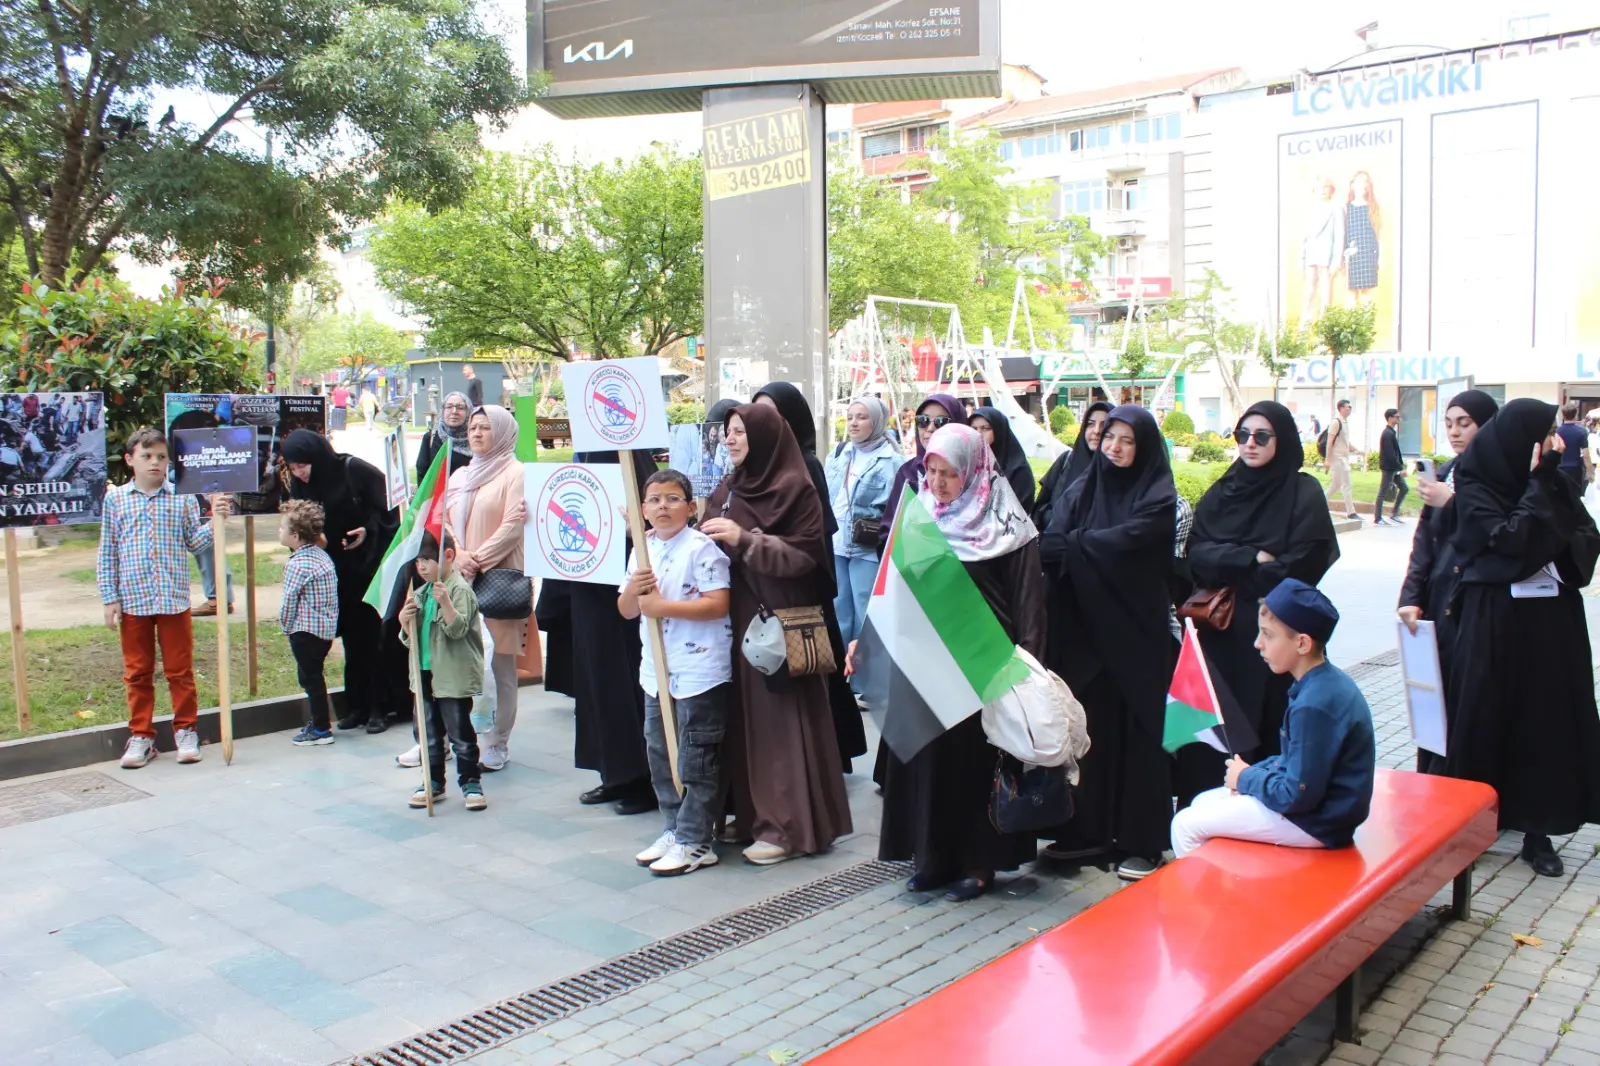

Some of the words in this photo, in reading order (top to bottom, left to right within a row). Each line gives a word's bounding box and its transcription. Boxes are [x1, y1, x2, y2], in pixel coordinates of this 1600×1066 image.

[929, 7, 961, 16] EFSANE
[940, 17, 961, 25] No:31
[908, 29, 922, 38] 262
[925, 28, 938, 38] 325
[563, 39, 633, 63] KIA
[1292, 86, 1333, 117] LC
[705, 112, 801, 153] REKLAM
[709, 136, 802, 168] REZERVASYON
[1287, 140, 1311, 156] LC
[1577, 352, 1600, 378] L
[613, 369, 630, 382] KAPAT
[290, 405, 319, 413] FESTİVAL
[211, 451, 253, 461] ANLAMAZ
[218, 457, 248, 466] ANLAR
[13, 479, 71, 498] ŞEHİD
[548, 469, 577, 492] KÜRECİĞİ
[578, 472, 599, 492] KAPAT
[11, 500, 84, 517] YARALI!
[549, 551, 571, 572] İSRAİLİ
[571, 563, 586, 573] KÖR
